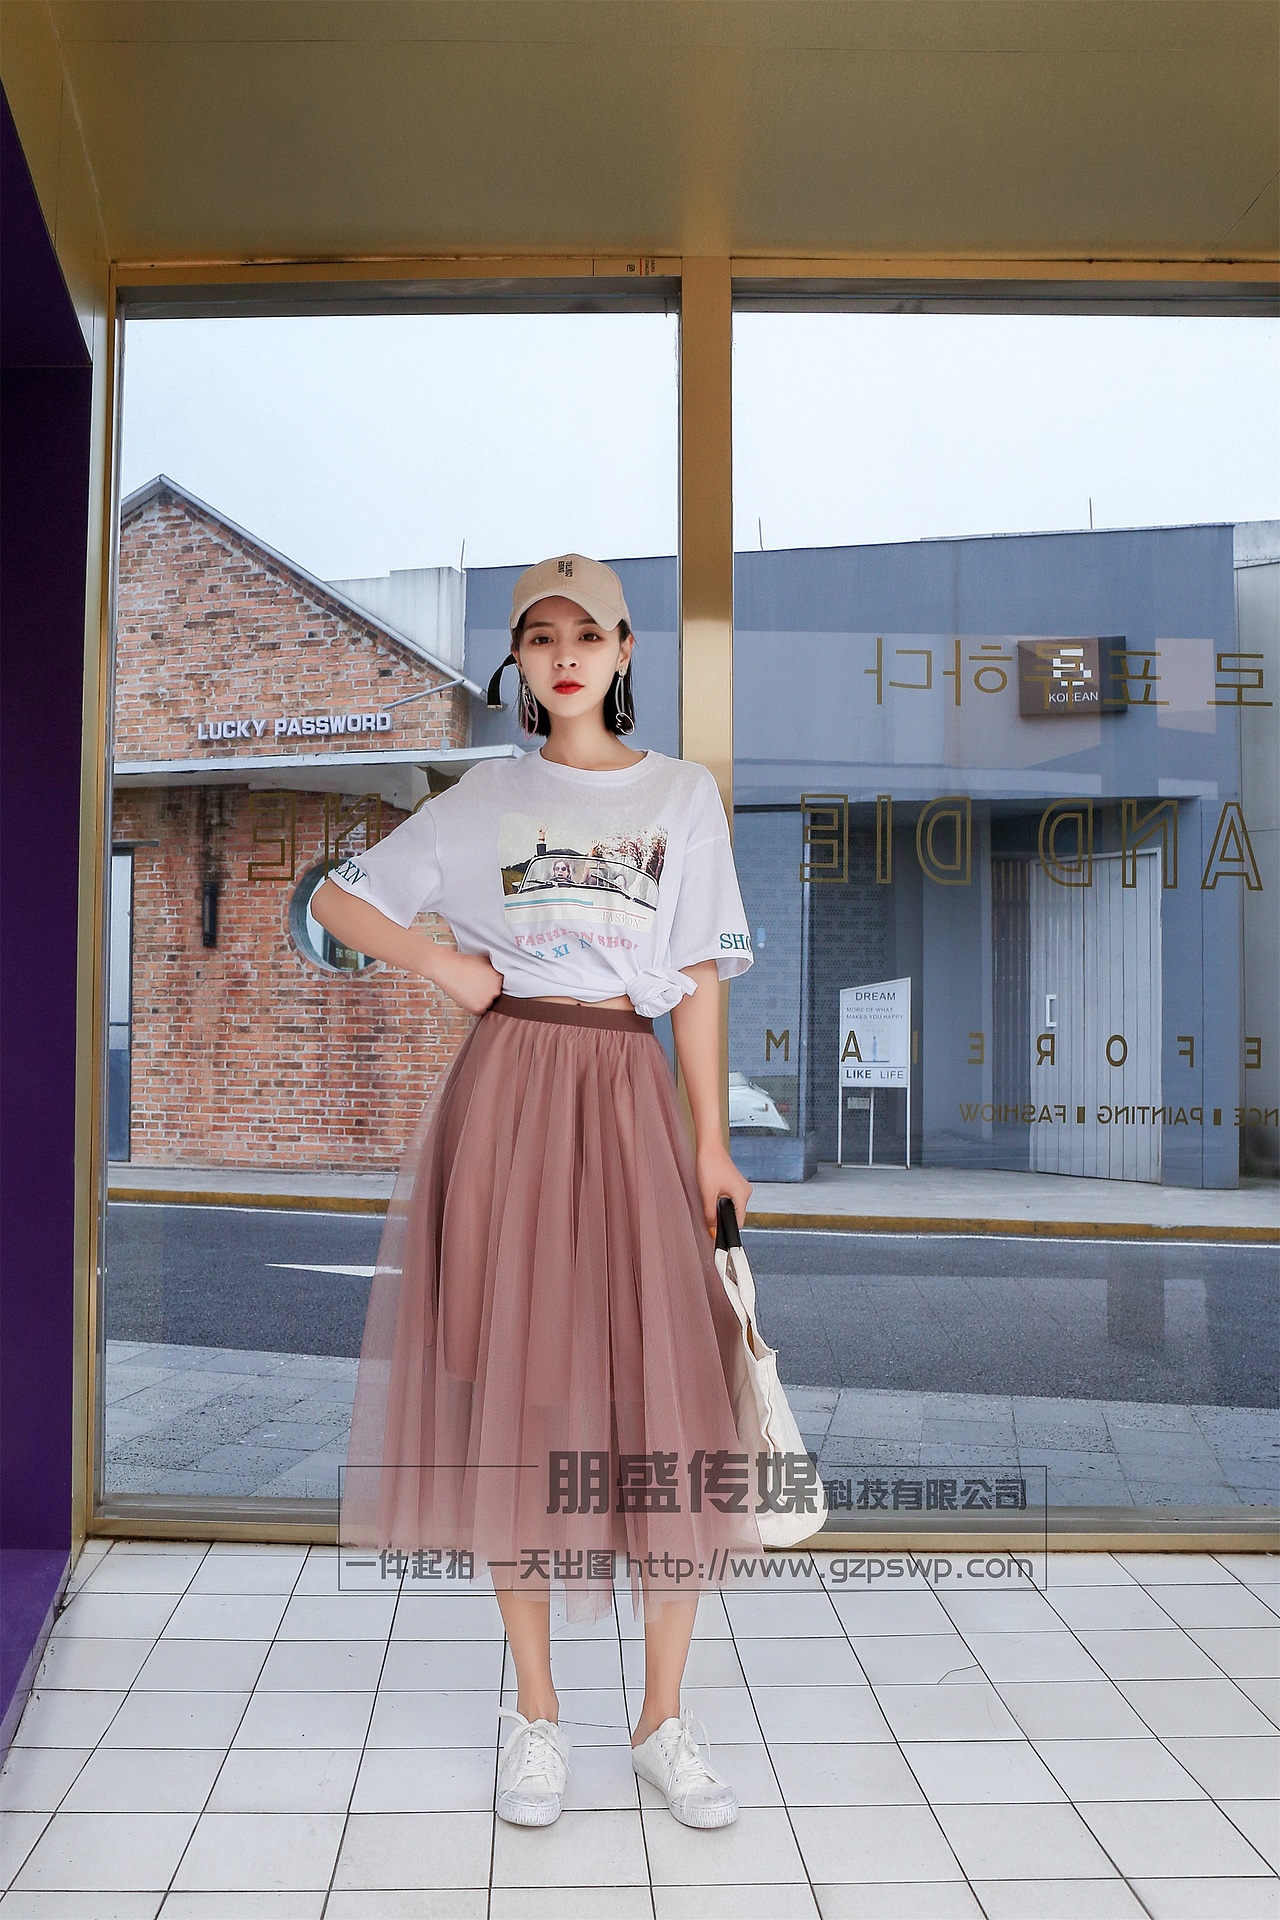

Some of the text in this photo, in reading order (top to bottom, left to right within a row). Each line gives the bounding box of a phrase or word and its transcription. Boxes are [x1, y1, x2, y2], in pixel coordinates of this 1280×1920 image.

[197, 712, 393, 740] LUCKY PASSWORD
[597, 935, 639, 951] SHO
[855, 991, 896, 1001] DREAM
[846, 1069, 904, 1080] LIKE LIFE
